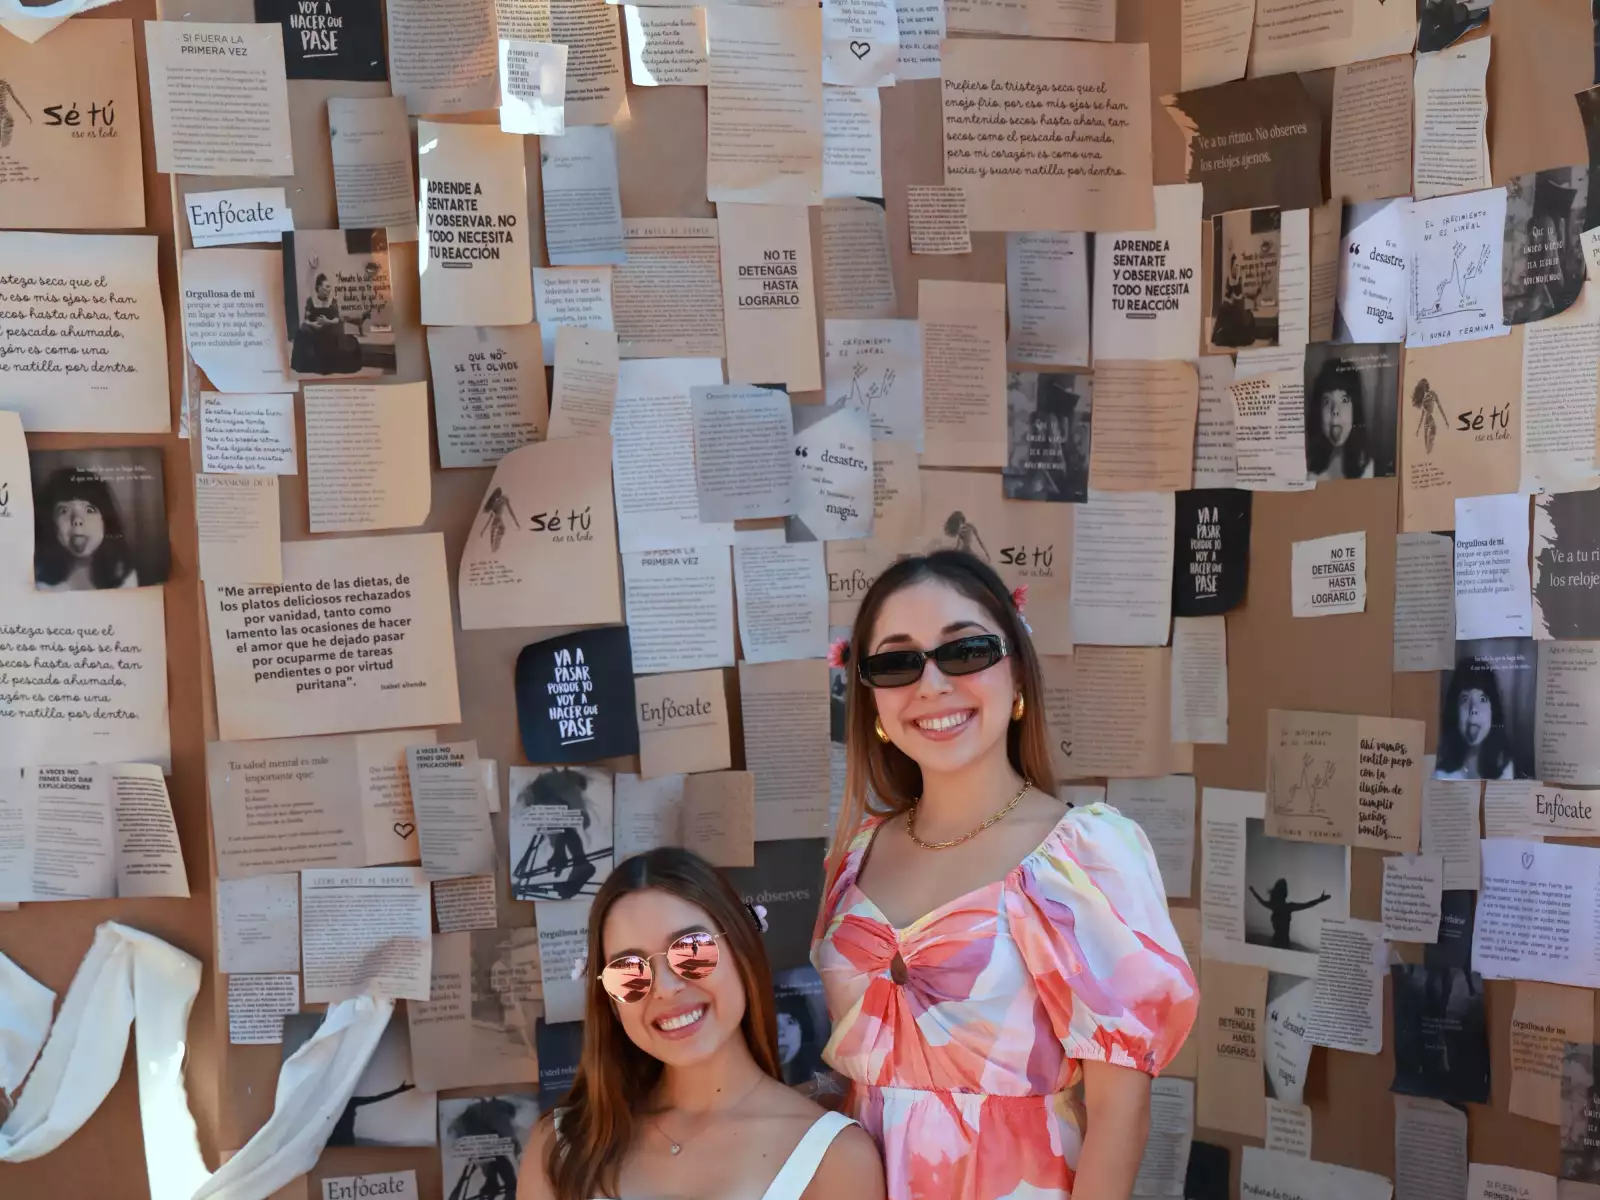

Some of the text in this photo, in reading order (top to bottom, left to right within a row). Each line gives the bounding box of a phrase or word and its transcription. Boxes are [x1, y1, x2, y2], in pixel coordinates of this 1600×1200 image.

[299, 1, 331, 14] VOY A
[290, 15, 343, 29] HACER QUE
[183, 34, 243, 44] SI FUERA LA
[301, 30, 338, 51] PASE
[181, 46, 248, 56] PRIMERA VEZ
[88, 100, 114, 126] tú
[1198, 137, 1209, 148] Ve
[1217, 137, 1227, 147] tu
[1229, 132, 1254, 145] ritmo.
[1255, 127, 1268, 140] No
[1270, 123, 1307, 138] observes
[1201, 152, 1271, 171] los relojes ajenos.
[427, 181, 481, 195] APRENDE A
[428, 198, 478, 211] SENTARTE
[190, 200, 274, 232] Enfócate
[429, 215, 516, 227] Y OBSERVAR. NO
[1426, 211, 1487, 229] EL CRECIMIENTO
[1439, 228, 1448, 236] ES
[1454, 222, 1481, 233] LINEAL
[429, 230, 513, 243] TODO NECESITA
[430, 244, 500, 259] TU REACCIÓN
[1114, 240, 1169, 251] APRENDE A
[764, 250, 796, 260] NO TE
[1113, 255, 1165, 266] SENTARTE
[1370, 247, 1406, 270] desastre,
[739, 266, 797, 276] DETENGAS
[1113, 268, 1193, 281] Y OBSERVAR. NO
[40, 276, 107, 289] seca que el
[763, 281, 798, 290] HASTA
[185, 290, 229, 300] Orgullosa
[231, 290, 241, 298] de
[1113, 284, 1189, 296] TODO NECESITA
[34, 292, 60, 302] mis
[63, 294, 89, 306] ojos
[93, 295, 107, 303] se
[109, 292, 137, 303] han
[739, 295, 798, 305] LOGRARLO
[1112, 297, 1179, 310] TU REACCIÓN
[30, 307, 139, 320] hasta ahora, tan
[1367, 305, 1394, 324] magia.
[7, 325, 124, 340] pescado ahumado,
[1430, 330, 1451, 339] NUNCA
[1459, 324, 1494, 335] TERMINA
[28, 346, 109, 355] es como una
[13, 360, 138, 375] natilla por dentro.
[1491, 402, 1510, 429] tú
[821, 450, 868, 472] desastre,
[568, 507, 591, 531] tú
[826, 504, 858, 521] magia.
[1033, 545, 1052, 567] tú
[1331, 548, 1355, 559] NO TE
[642, 557, 699, 566] PRIMERA VEZ
[1312, 562, 1355, 575] DETENGAS
[248, 582, 313, 596] arrepiento
[316, 580, 331, 590] de
[334, 578, 350, 589] las
[353, 576, 392, 588] dietas,
[395, 573, 410, 584] de
[1329, 577, 1356, 588] HASTA
[220, 587, 411, 613] los platos deliciosos rechazados
[1312, 591, 1356, 604] LOGRARLO
[244, 605, 391, 627] por vanidad, tanto como
[226, 617, 412, 640] lamento las ocasiones de hacer
[236, 632, 405, 653] el amor que he dejado pasar
[253, 647, 393, 669] por ocuparme de tareas
[554, 648, 584, 666] VA A
[255, 659, 393, 683] pendientes o por virtud
[555, 666, 590, 682] PASAR
[548, 681, 592, 694] PORQUE YO
[556, 693, 587, 706] VOY A
[549, 704, 599, 719] HACER QUE
[640, 697, 712, 726] Enfócate
[559, 718, 593, 738] PASE
[1377, 742, 1407, 755] vamos,
[1360, 768, 1386, 779] con la
[1359, 781, 1402, 795] ilusión de
[1536, 794, 1592, 822] Enfócate
[1359, 810, 1387, 825] sueños
